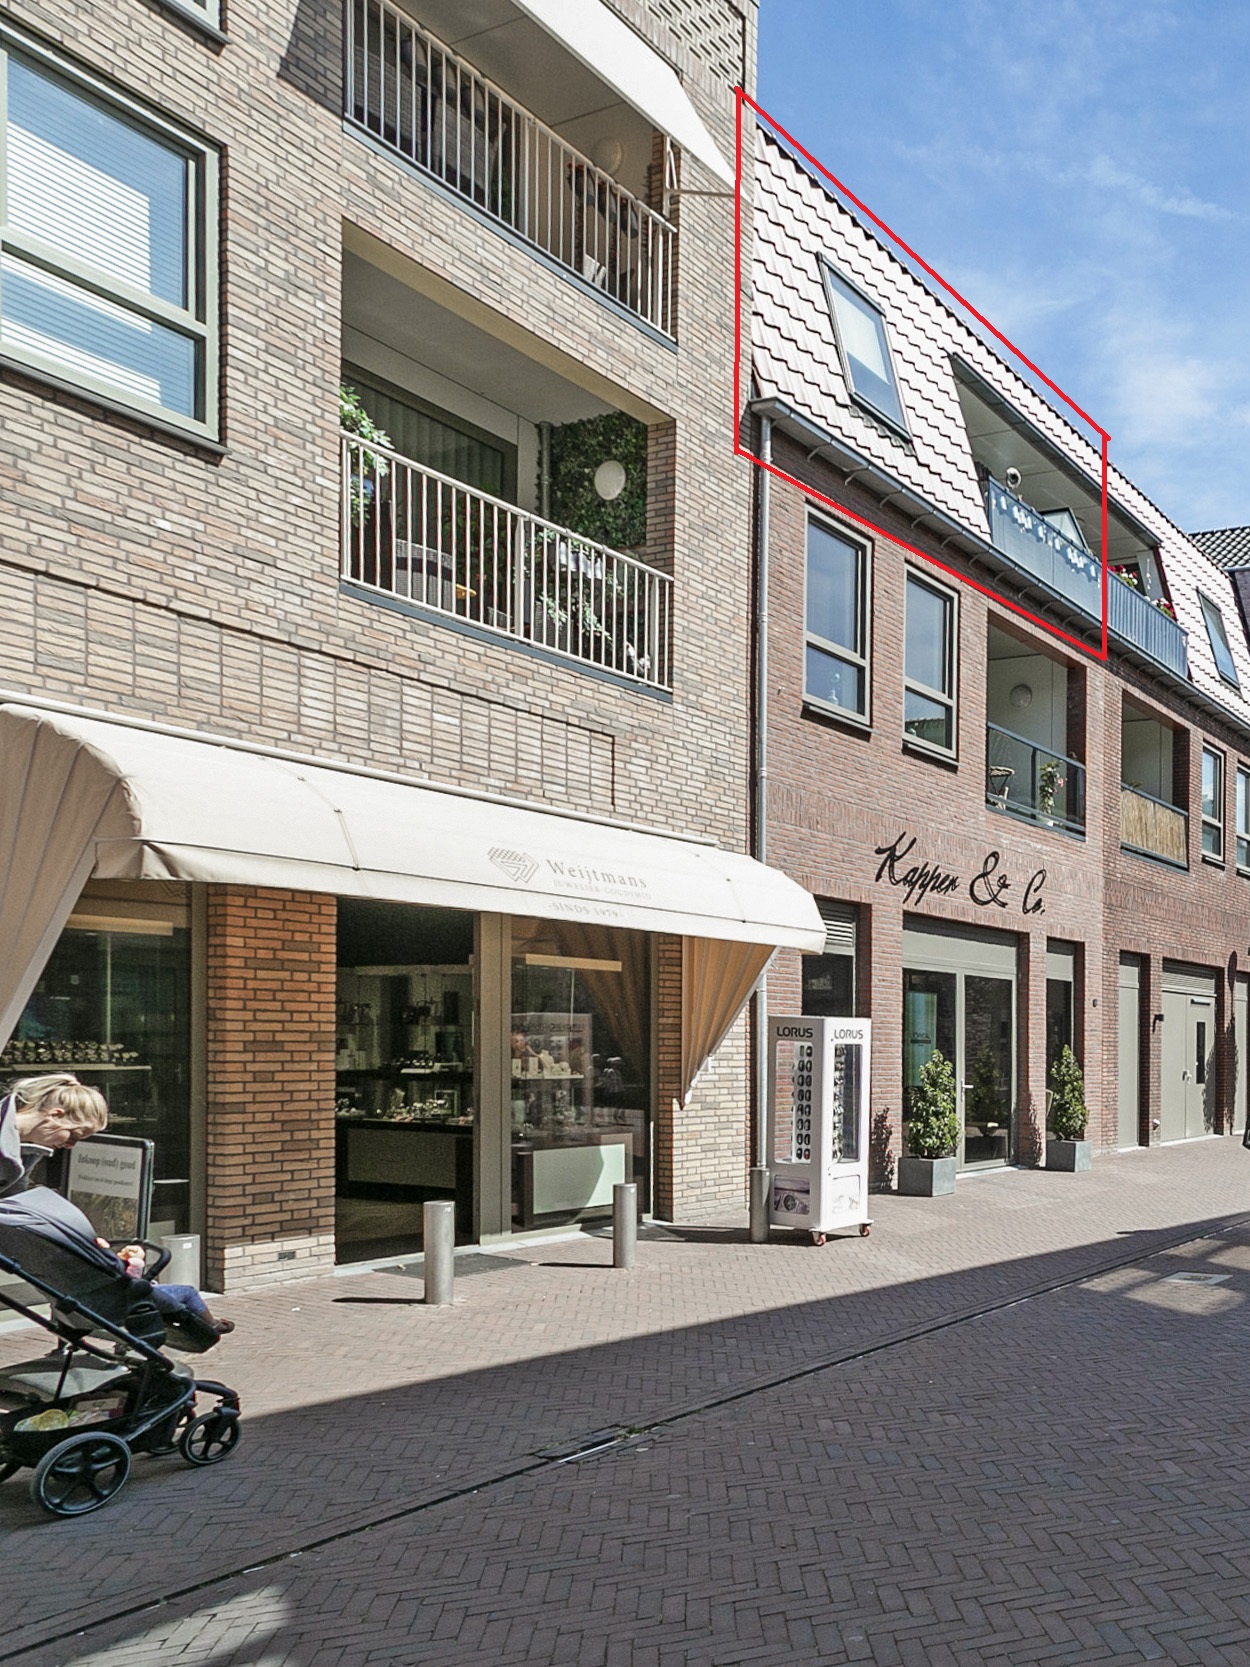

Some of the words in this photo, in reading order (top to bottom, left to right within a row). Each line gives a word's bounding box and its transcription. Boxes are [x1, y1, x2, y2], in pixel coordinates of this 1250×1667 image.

[546, 859, 648, 889] Weijtmans
[969, 850, 1011, 908] &
[776, 1026, 813, 1038] LORUS
[833, 1029, 864, 1040] LORUS
